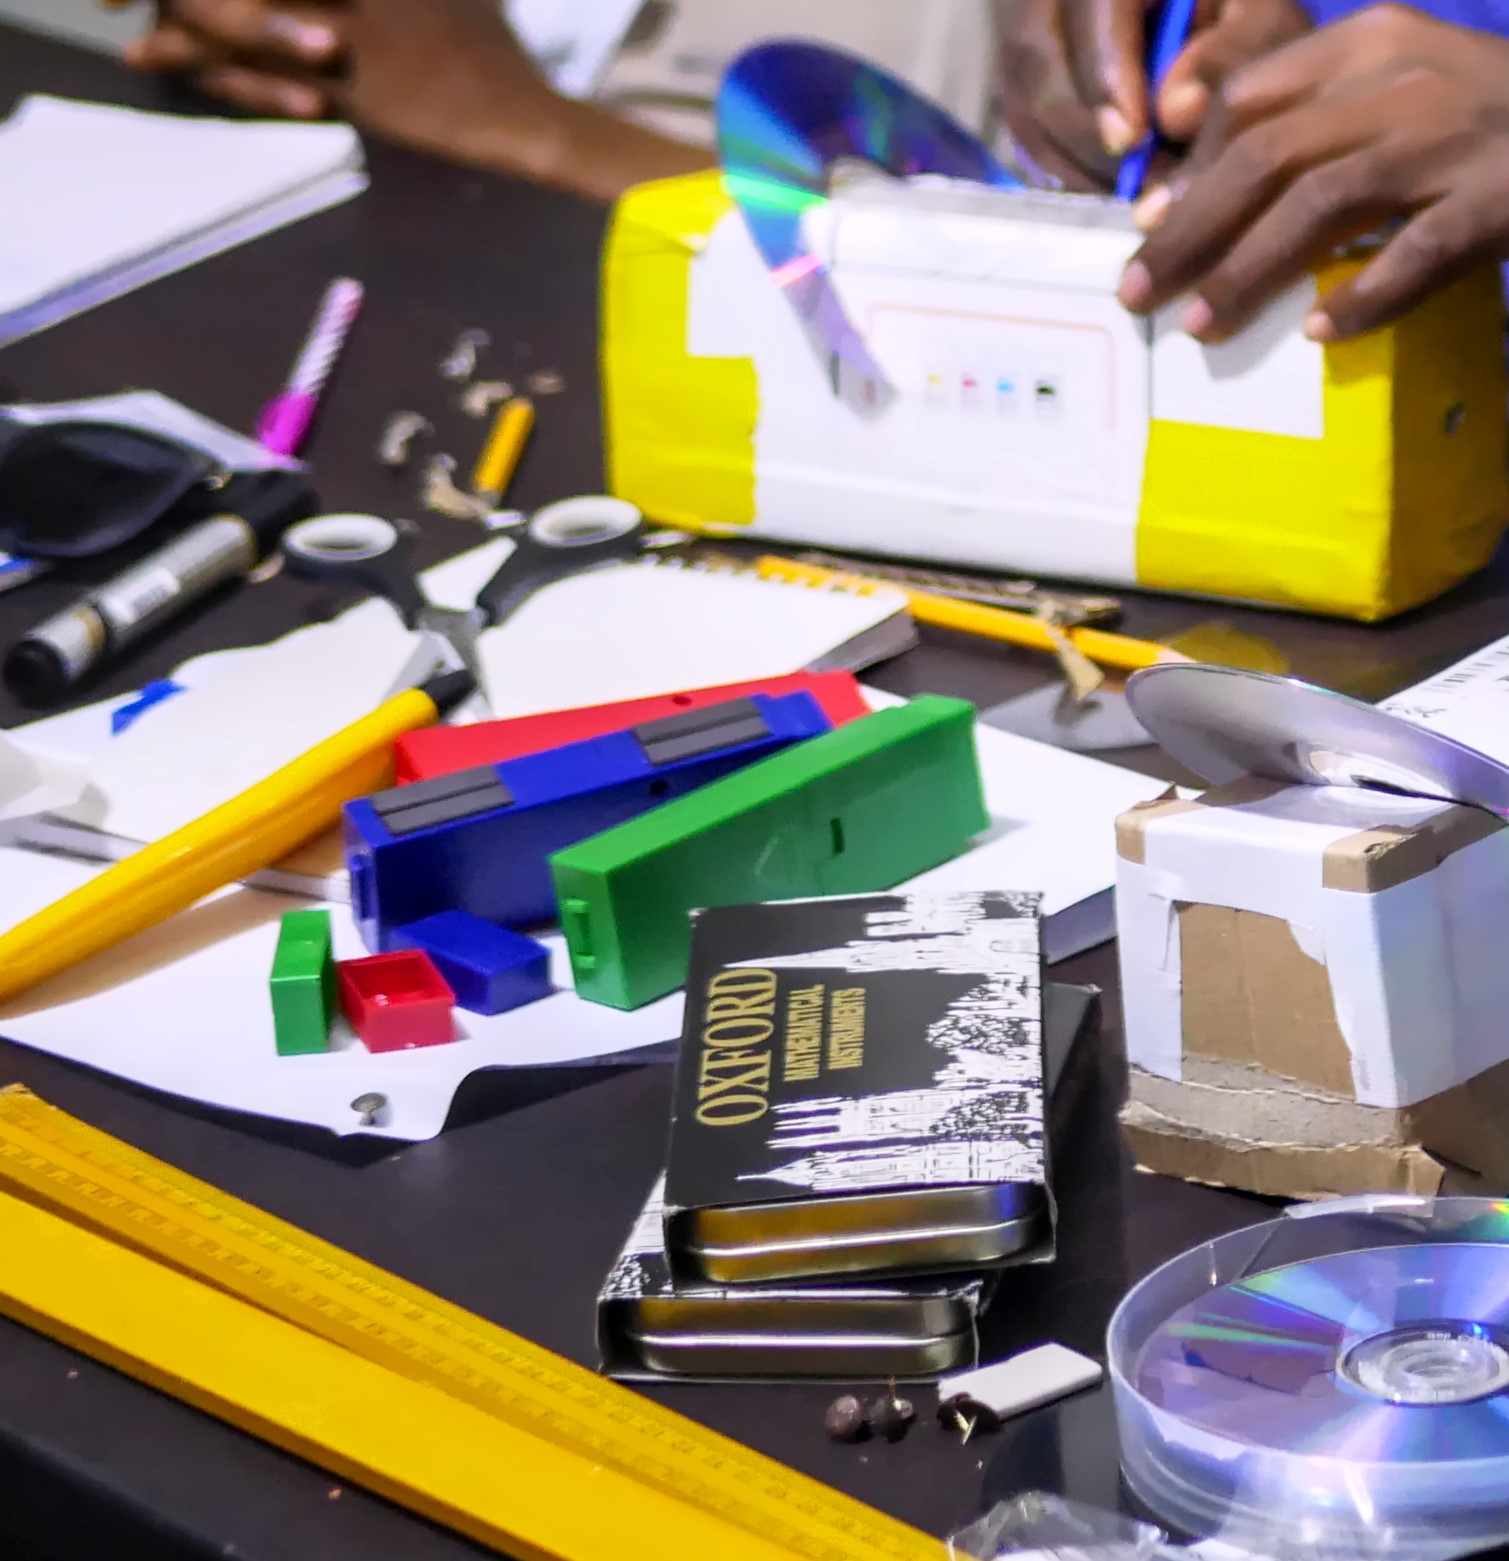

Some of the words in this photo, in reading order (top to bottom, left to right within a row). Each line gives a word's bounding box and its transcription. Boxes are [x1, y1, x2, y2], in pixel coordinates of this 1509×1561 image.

[697, 968, 776, 1126] OXFORD
[783, 983, 825, 1082] MATHEMATICAL
[827, 986, 866, 1070] INSTRUMENTS
